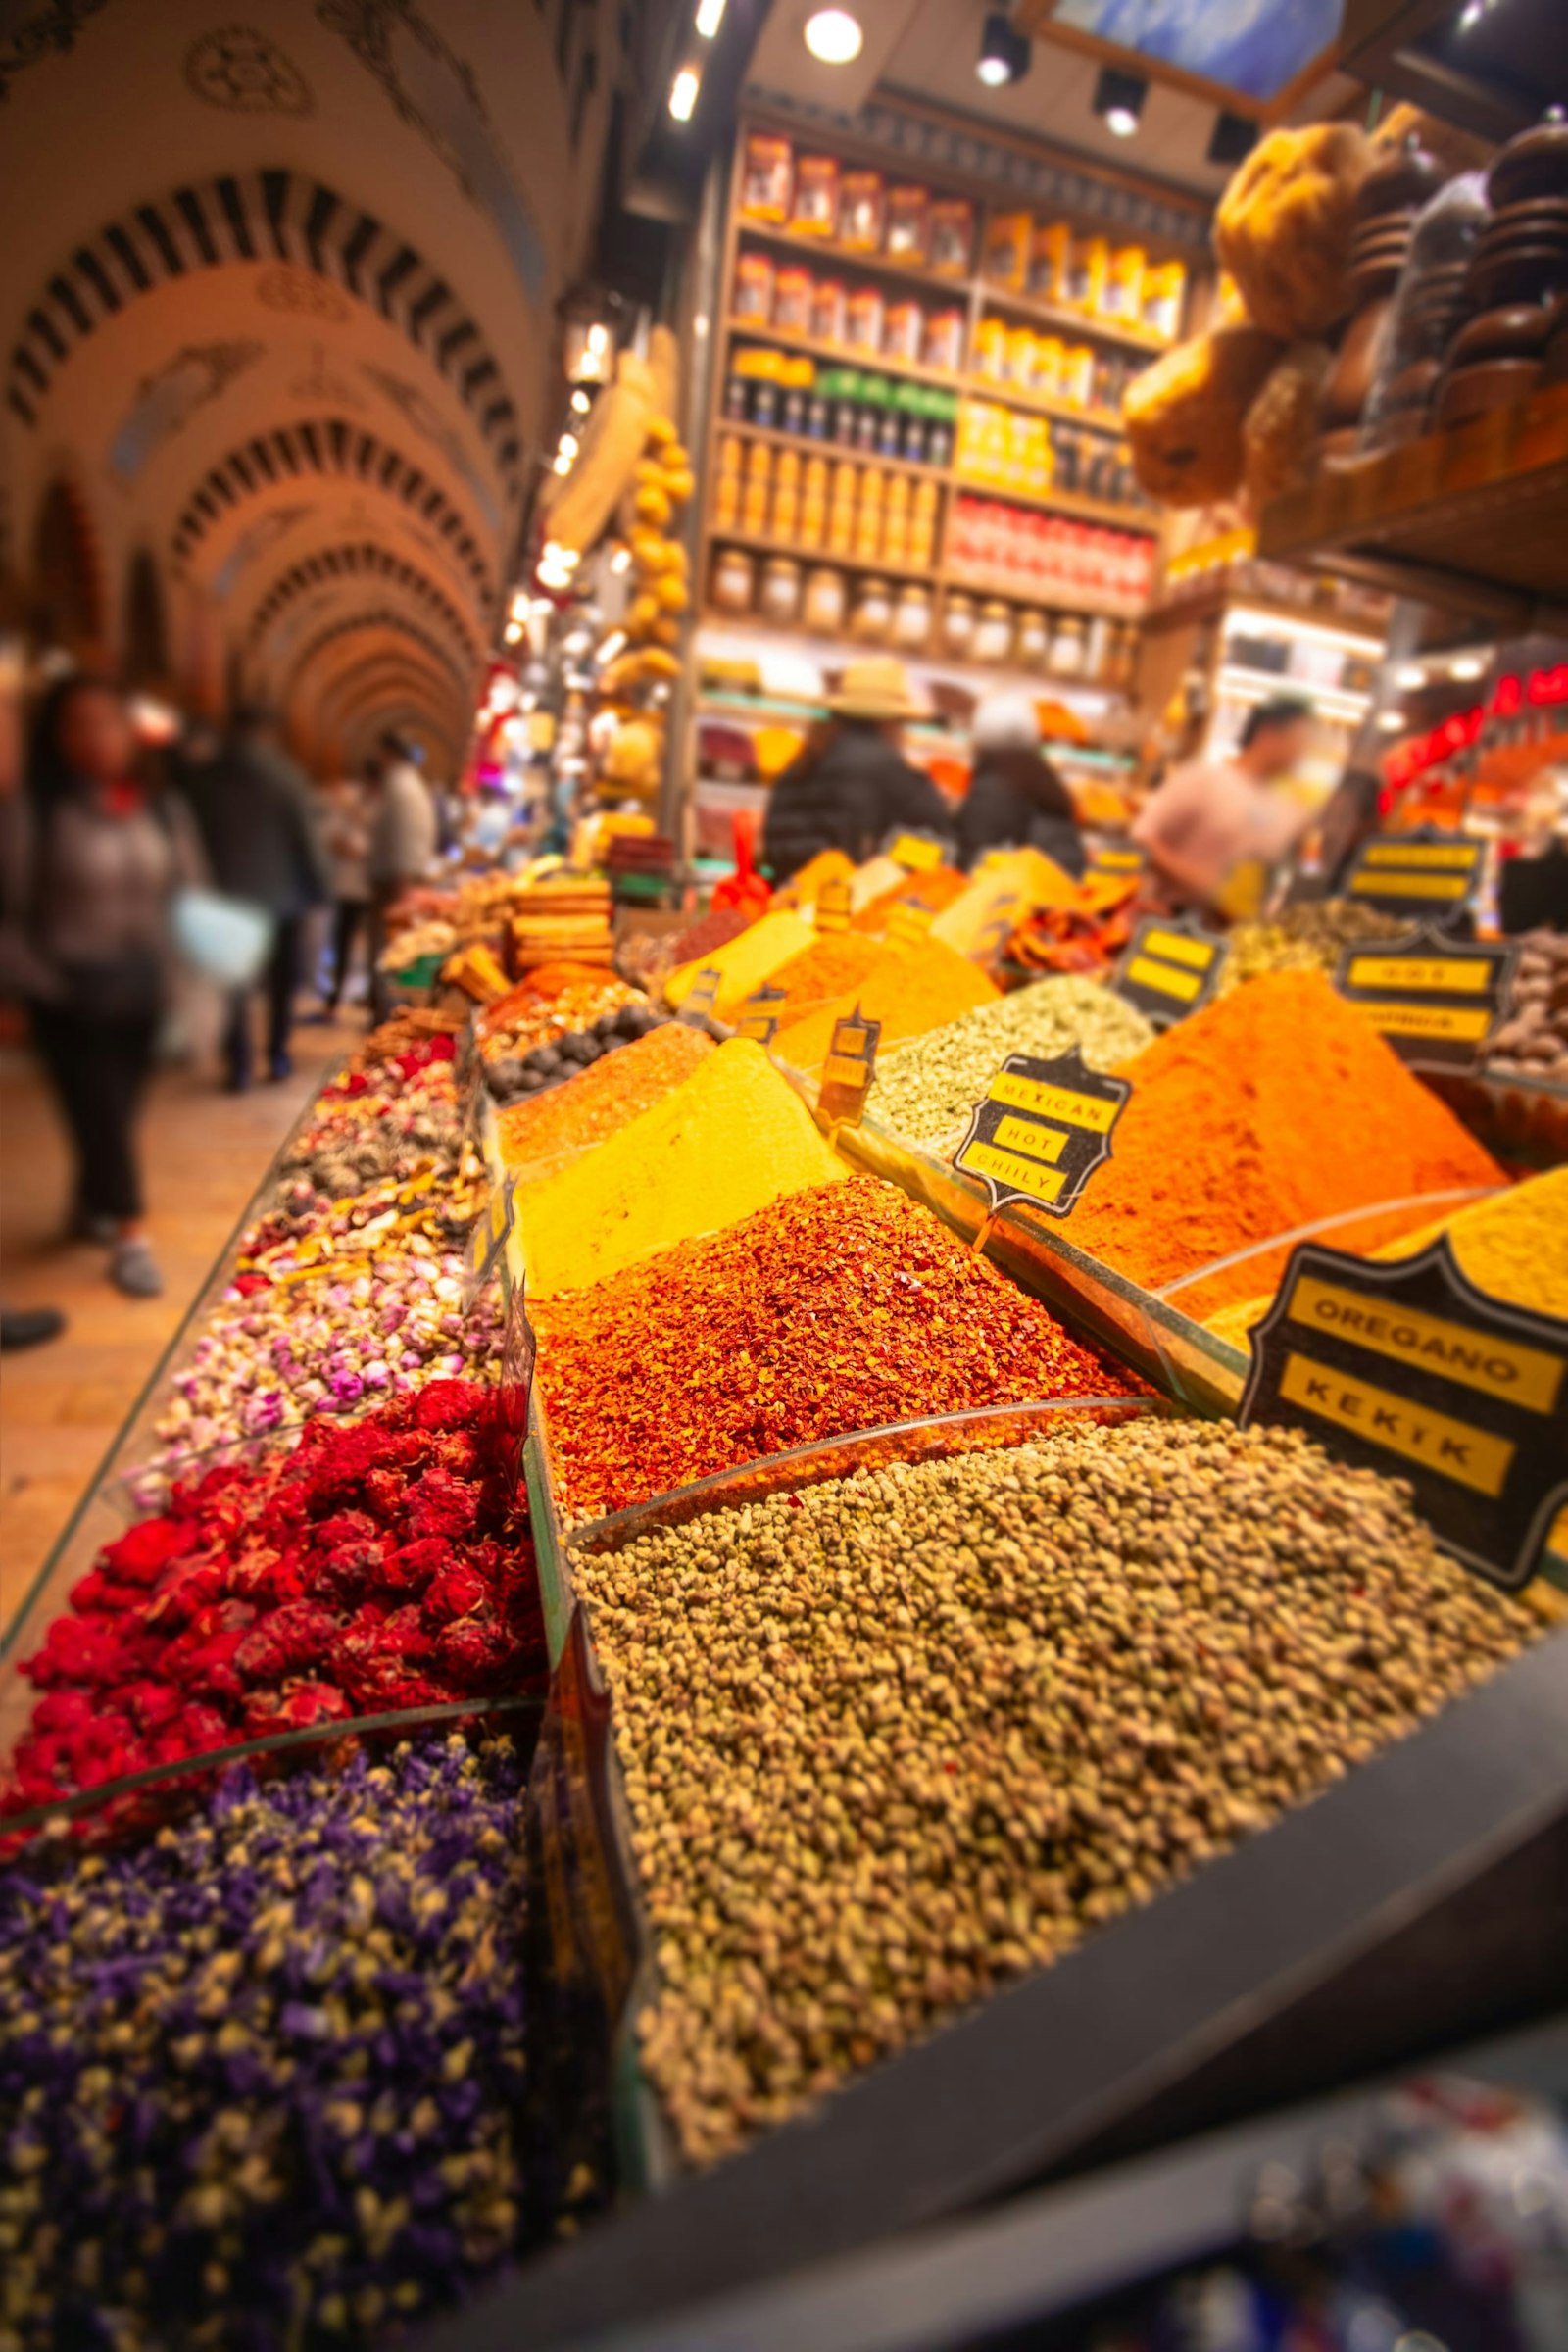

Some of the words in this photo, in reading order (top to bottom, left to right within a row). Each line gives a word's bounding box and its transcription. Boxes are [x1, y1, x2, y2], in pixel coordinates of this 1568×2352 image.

[1004, 1085, 1102, 1121] MEXICAN
[1008, 1129, 1052, 1150] HOT
[1314, 1299, 1518, 1384] OREGANO
[1306, 1377, 1470, 1465] KEKIK
